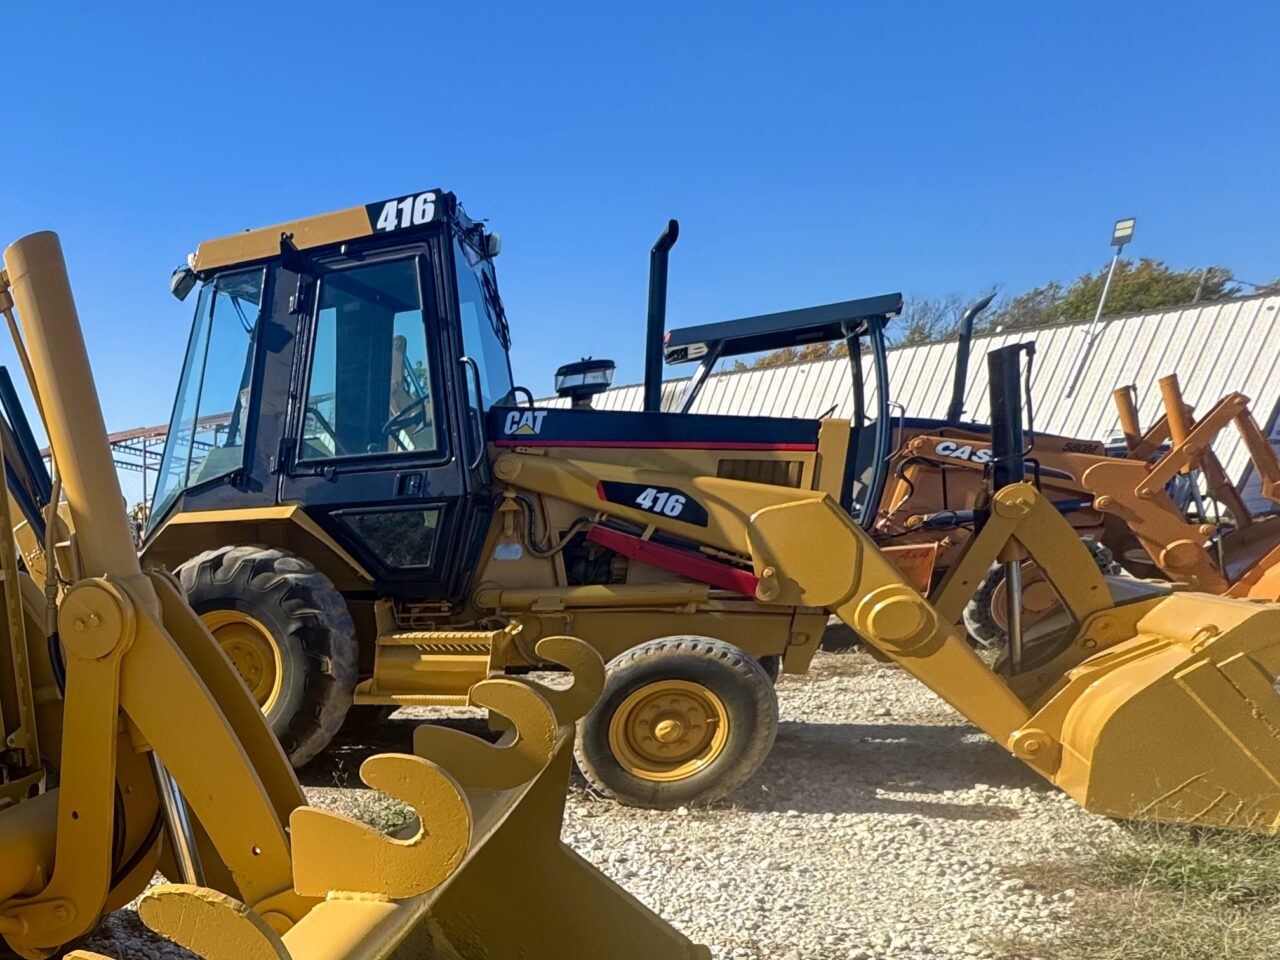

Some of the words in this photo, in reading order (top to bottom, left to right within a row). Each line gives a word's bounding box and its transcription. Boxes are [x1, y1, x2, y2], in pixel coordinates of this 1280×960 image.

[376, 192, 436, 232] 416
[504, 410, 548, 435] CAT
[935, 441, 993, 463] CAS
[635, 487, 686, 517] 416
